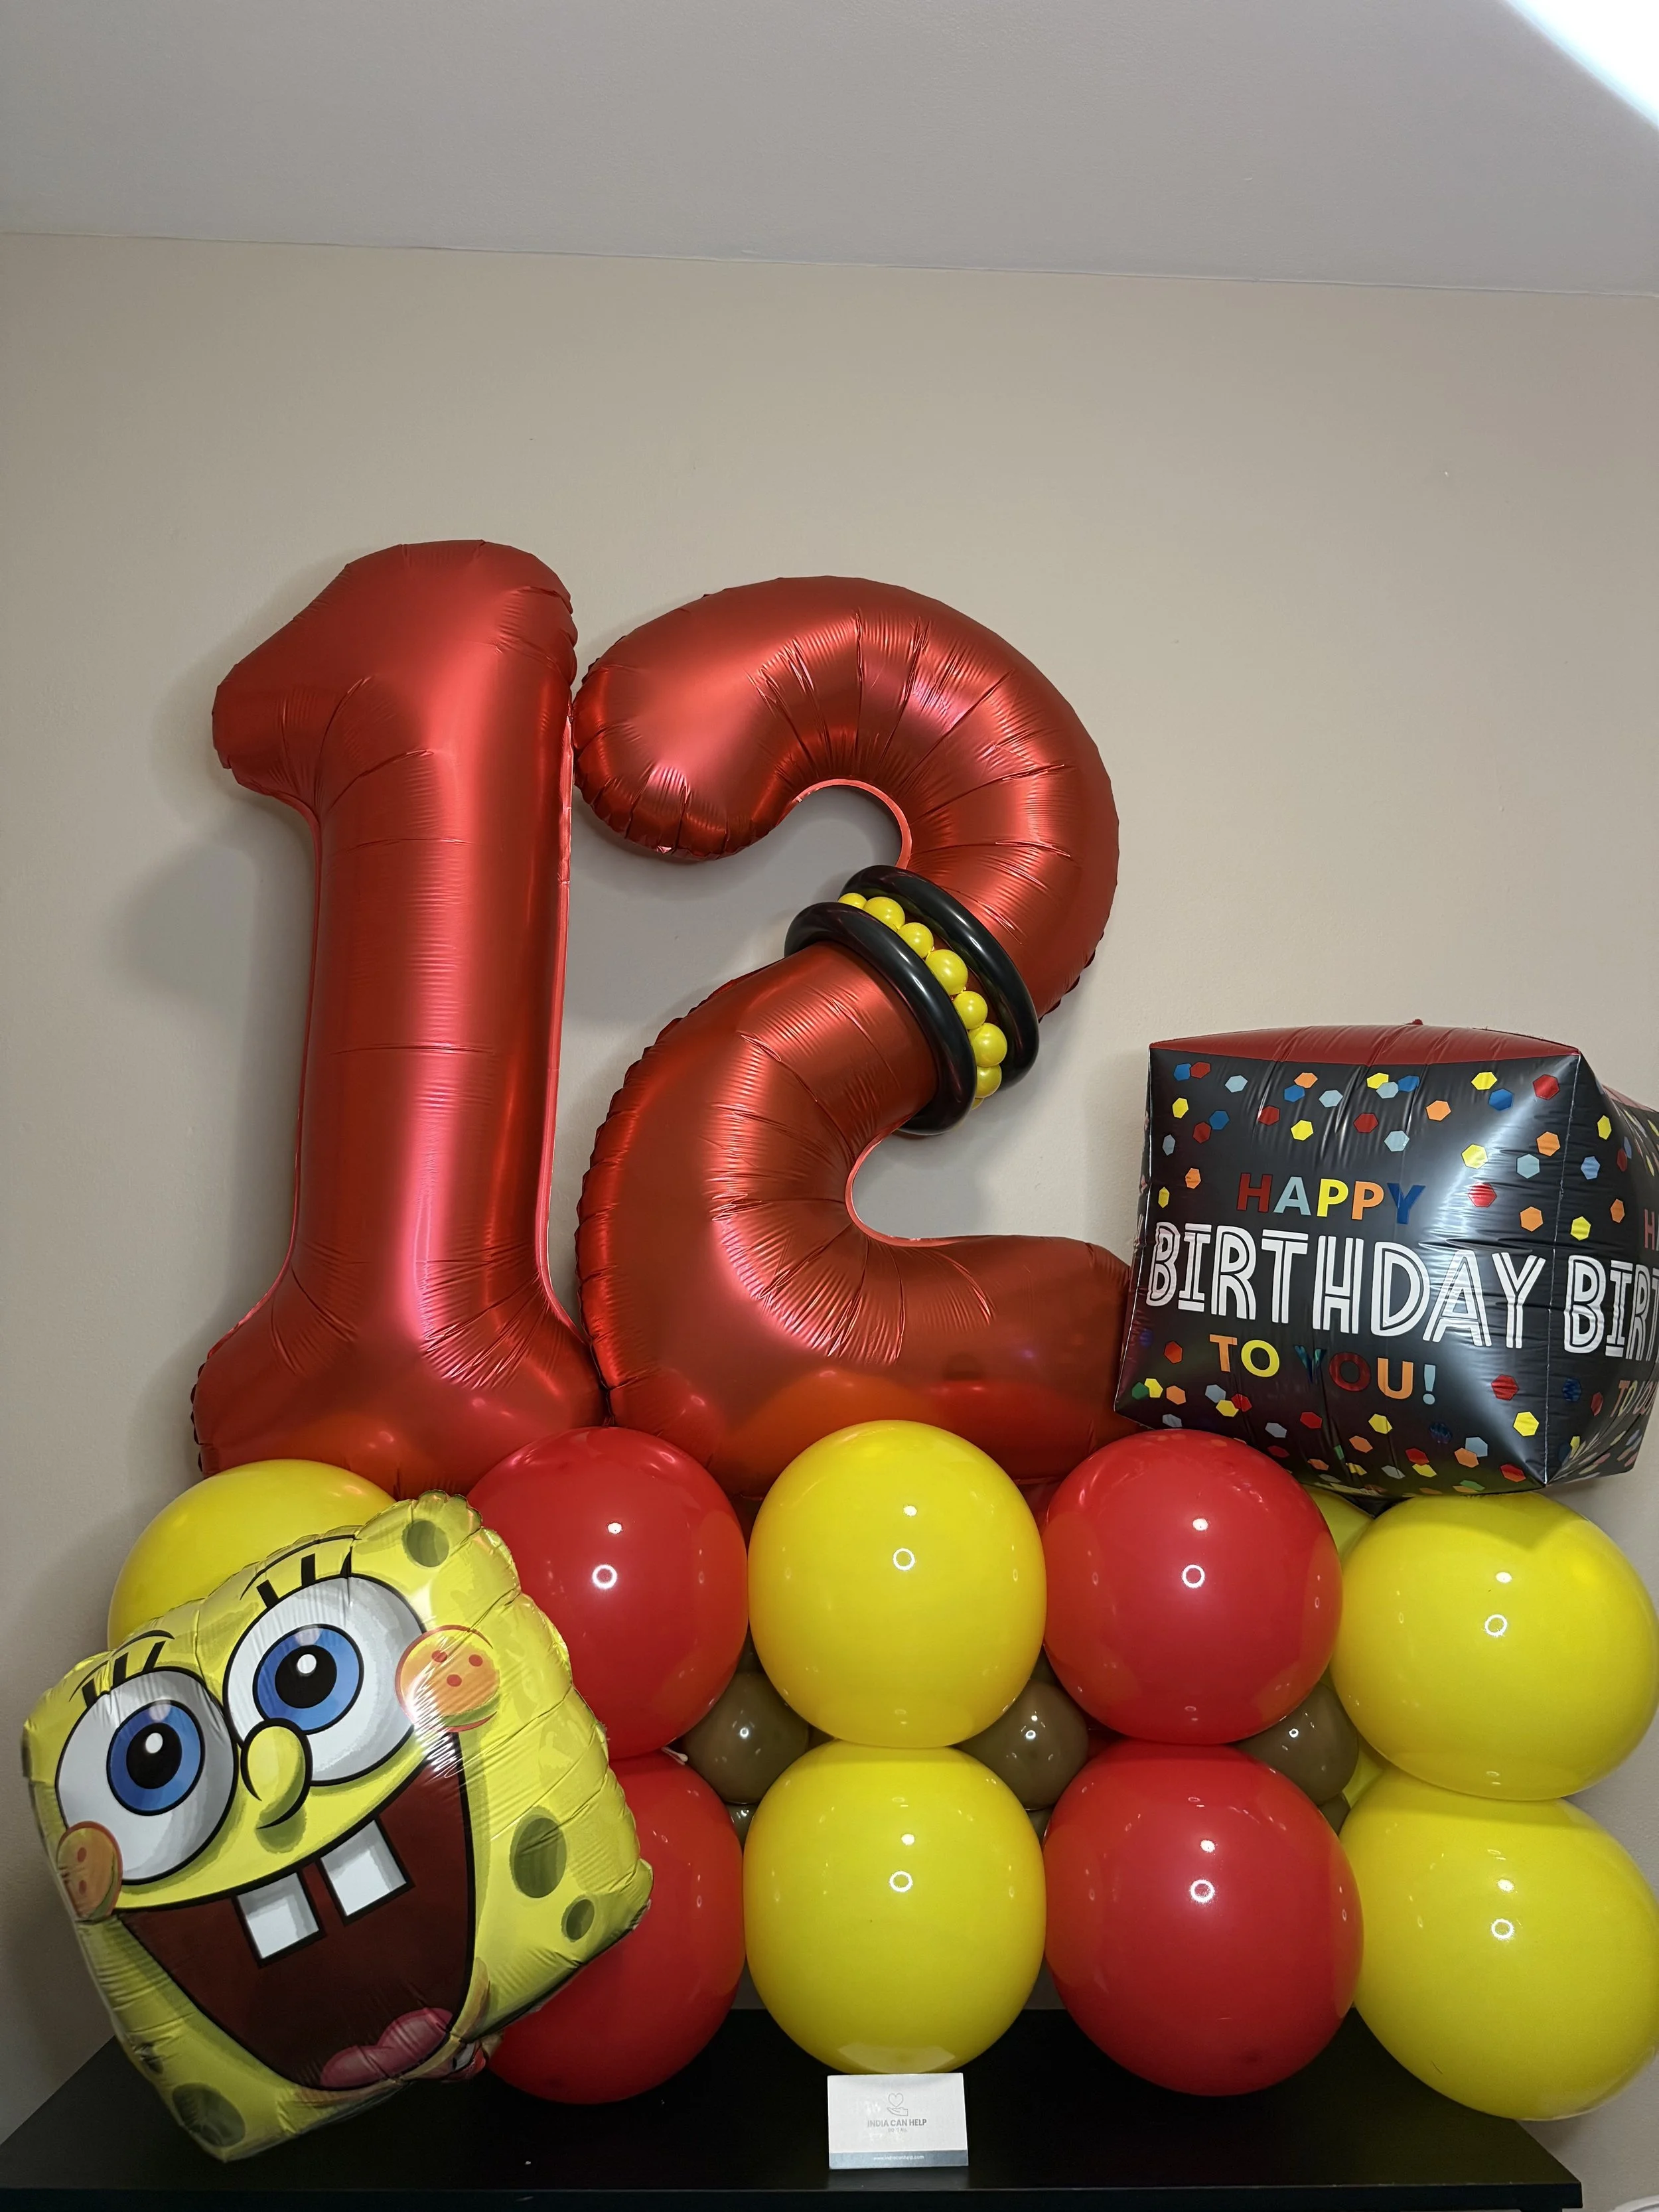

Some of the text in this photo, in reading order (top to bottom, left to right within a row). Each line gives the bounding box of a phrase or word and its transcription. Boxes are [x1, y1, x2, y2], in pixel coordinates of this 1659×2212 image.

[1236, 1173, 1425, 1224] HAPPY
[1146, 1222, 1546, 1349] BIRTHDAY
[1563, 1255, 1659, 1363] BIRT
[1209, 1335, 1436, 1405] TO YOU!
[867, 2119, 889, 2128] INDIA
